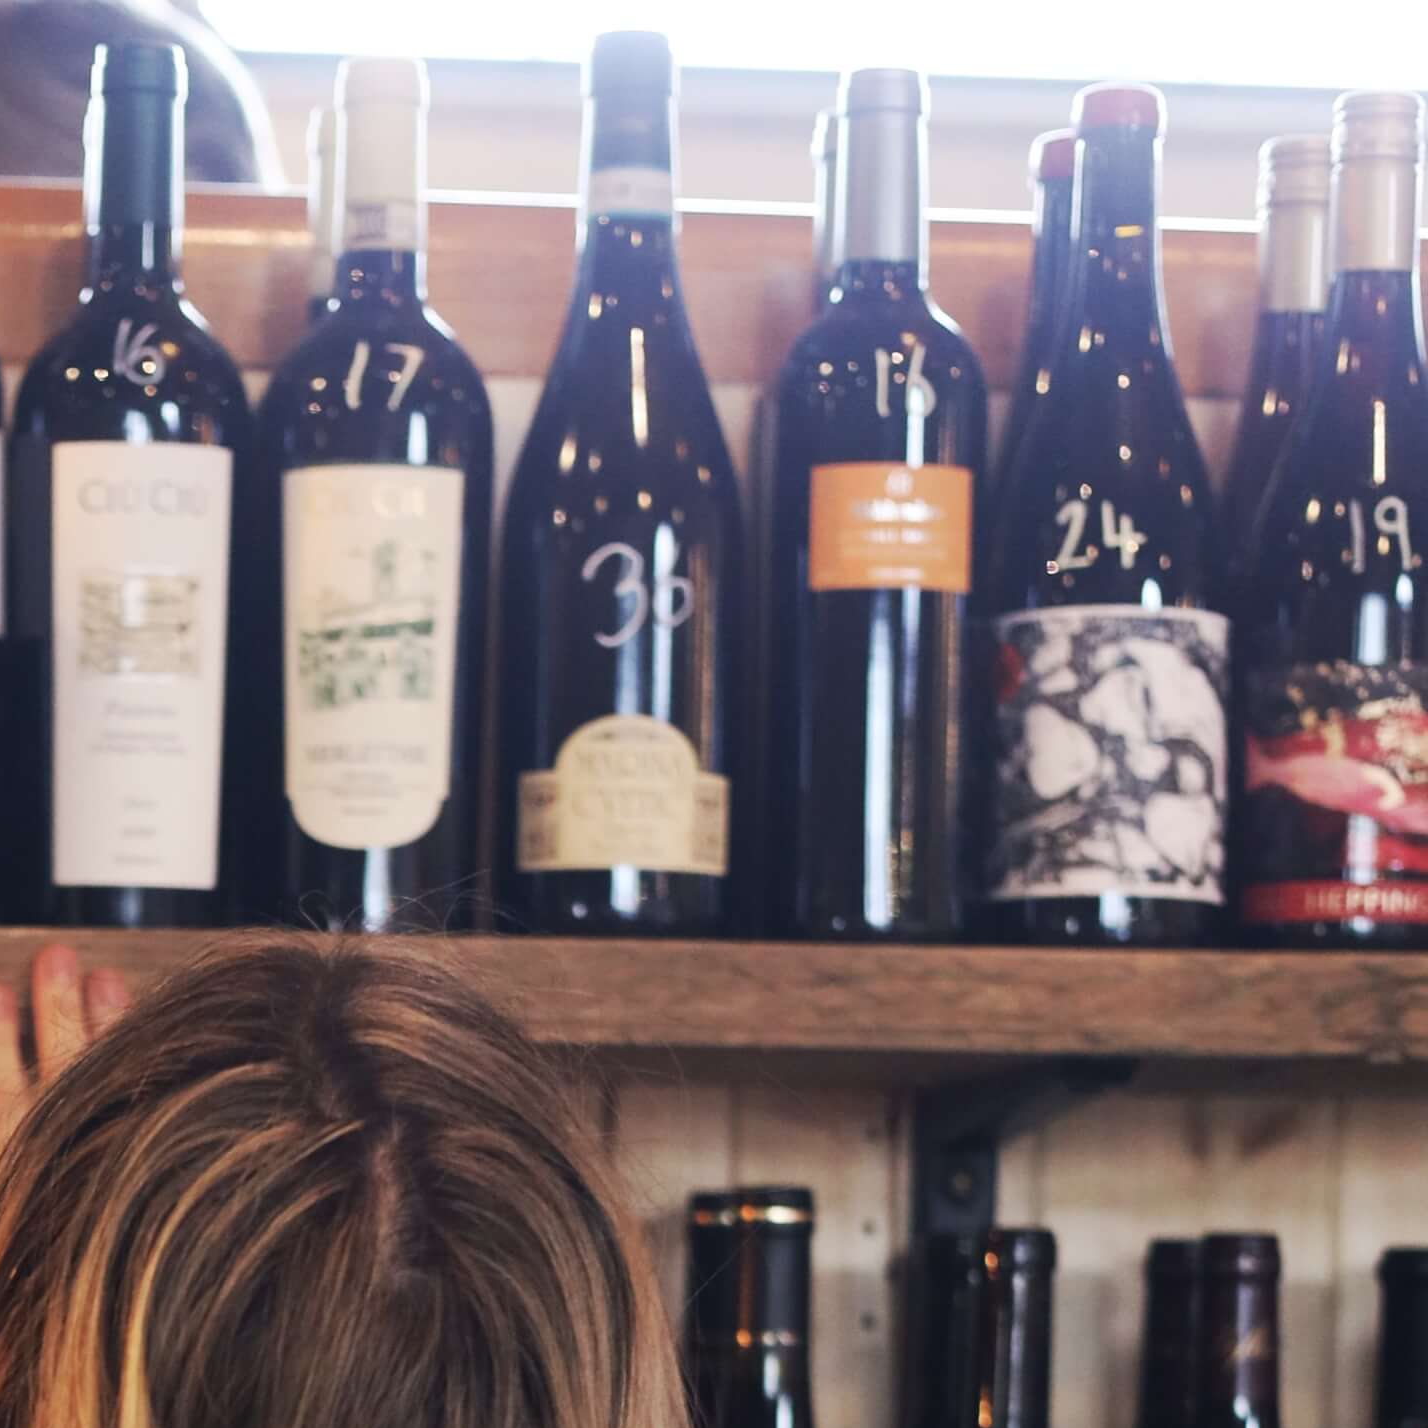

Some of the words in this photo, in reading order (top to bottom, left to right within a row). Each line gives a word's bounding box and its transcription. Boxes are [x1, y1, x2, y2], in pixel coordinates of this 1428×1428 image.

[113, 319, 165, 384] 16
[345, 341, 424, 411] 17
[875, 340, 936, 418] 16
[1055, 499, 1147, 569] 24
[1350, 495, 1413, 575] 19
[581, 540, 695, 648] 36
